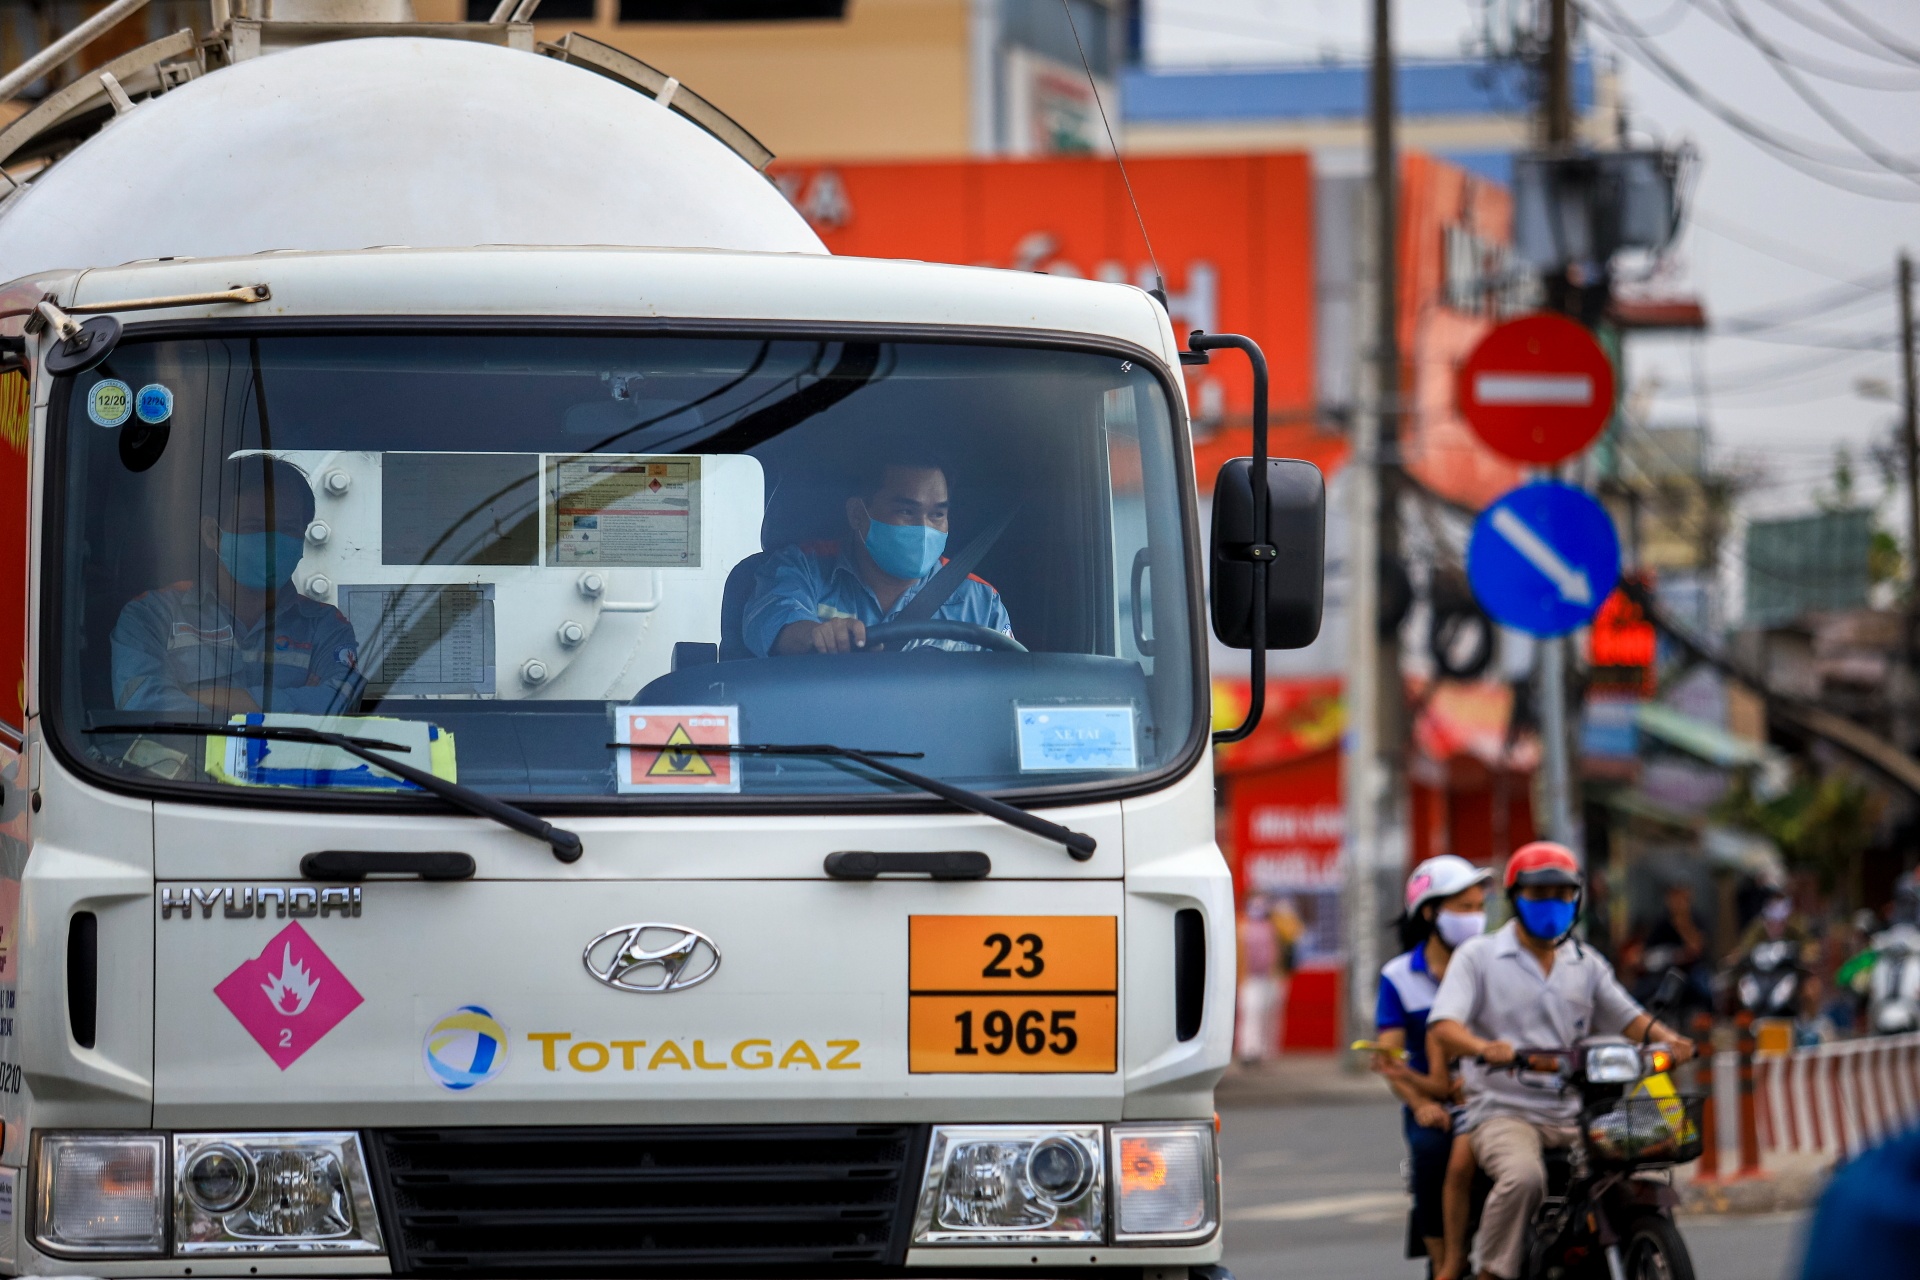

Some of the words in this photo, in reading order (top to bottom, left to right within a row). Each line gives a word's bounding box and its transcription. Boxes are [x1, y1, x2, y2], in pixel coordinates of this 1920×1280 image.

[98, 395, 126, 406] 12/20
[142, 396, 165, 406] 12/20
[162, 887, 362, 919] HYUNDAI
[982, 933, 1045, 978] 23
[279, 1028, 293, 1048] 2
[954, 1010, 1078, 1055] 1965
[527, 1031, 862, 1072] TOTALGAZ
